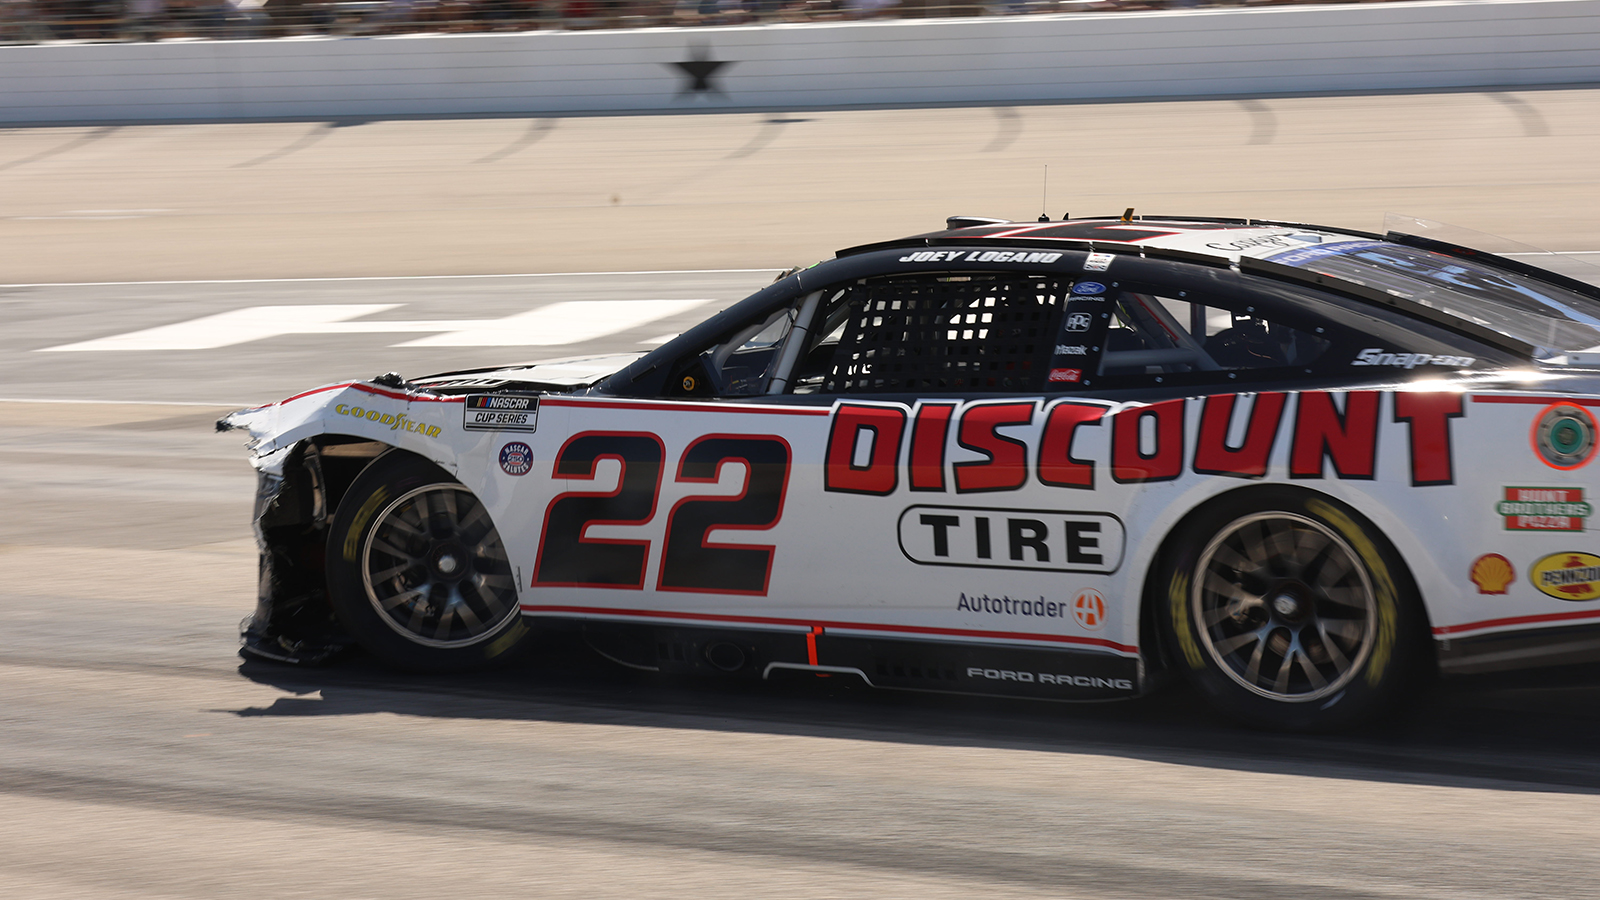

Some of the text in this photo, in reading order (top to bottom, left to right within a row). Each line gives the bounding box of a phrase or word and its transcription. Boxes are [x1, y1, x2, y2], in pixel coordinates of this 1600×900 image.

[899, 251, 1063, 264] JOEY LOGANO
[1350, 348, 1476, 369] Snap-on
[488, 396, 529, 410] NASCAR
[335, 403, 442, 438] GOODYEAR
[475, 412, 528, 424] CUP SERIES
[504, 444, 529, 456] NASCAR
[824, 391, 1468, 497] DISCOUNT
[503, 462, 529, 474] SALUTES
[1517, 489, 1569, 502] HUNT
[531, 430, 793, 597] 22
[1500, 502, 1589, 516] BROTHERS
[1517, 515, 1571, 528] PIZZA
[919, 513, 1103, 565] TIRE
[957, 592, 1067, 618] Autotrader
[967, 667, 1132, 690] FORD RACING
